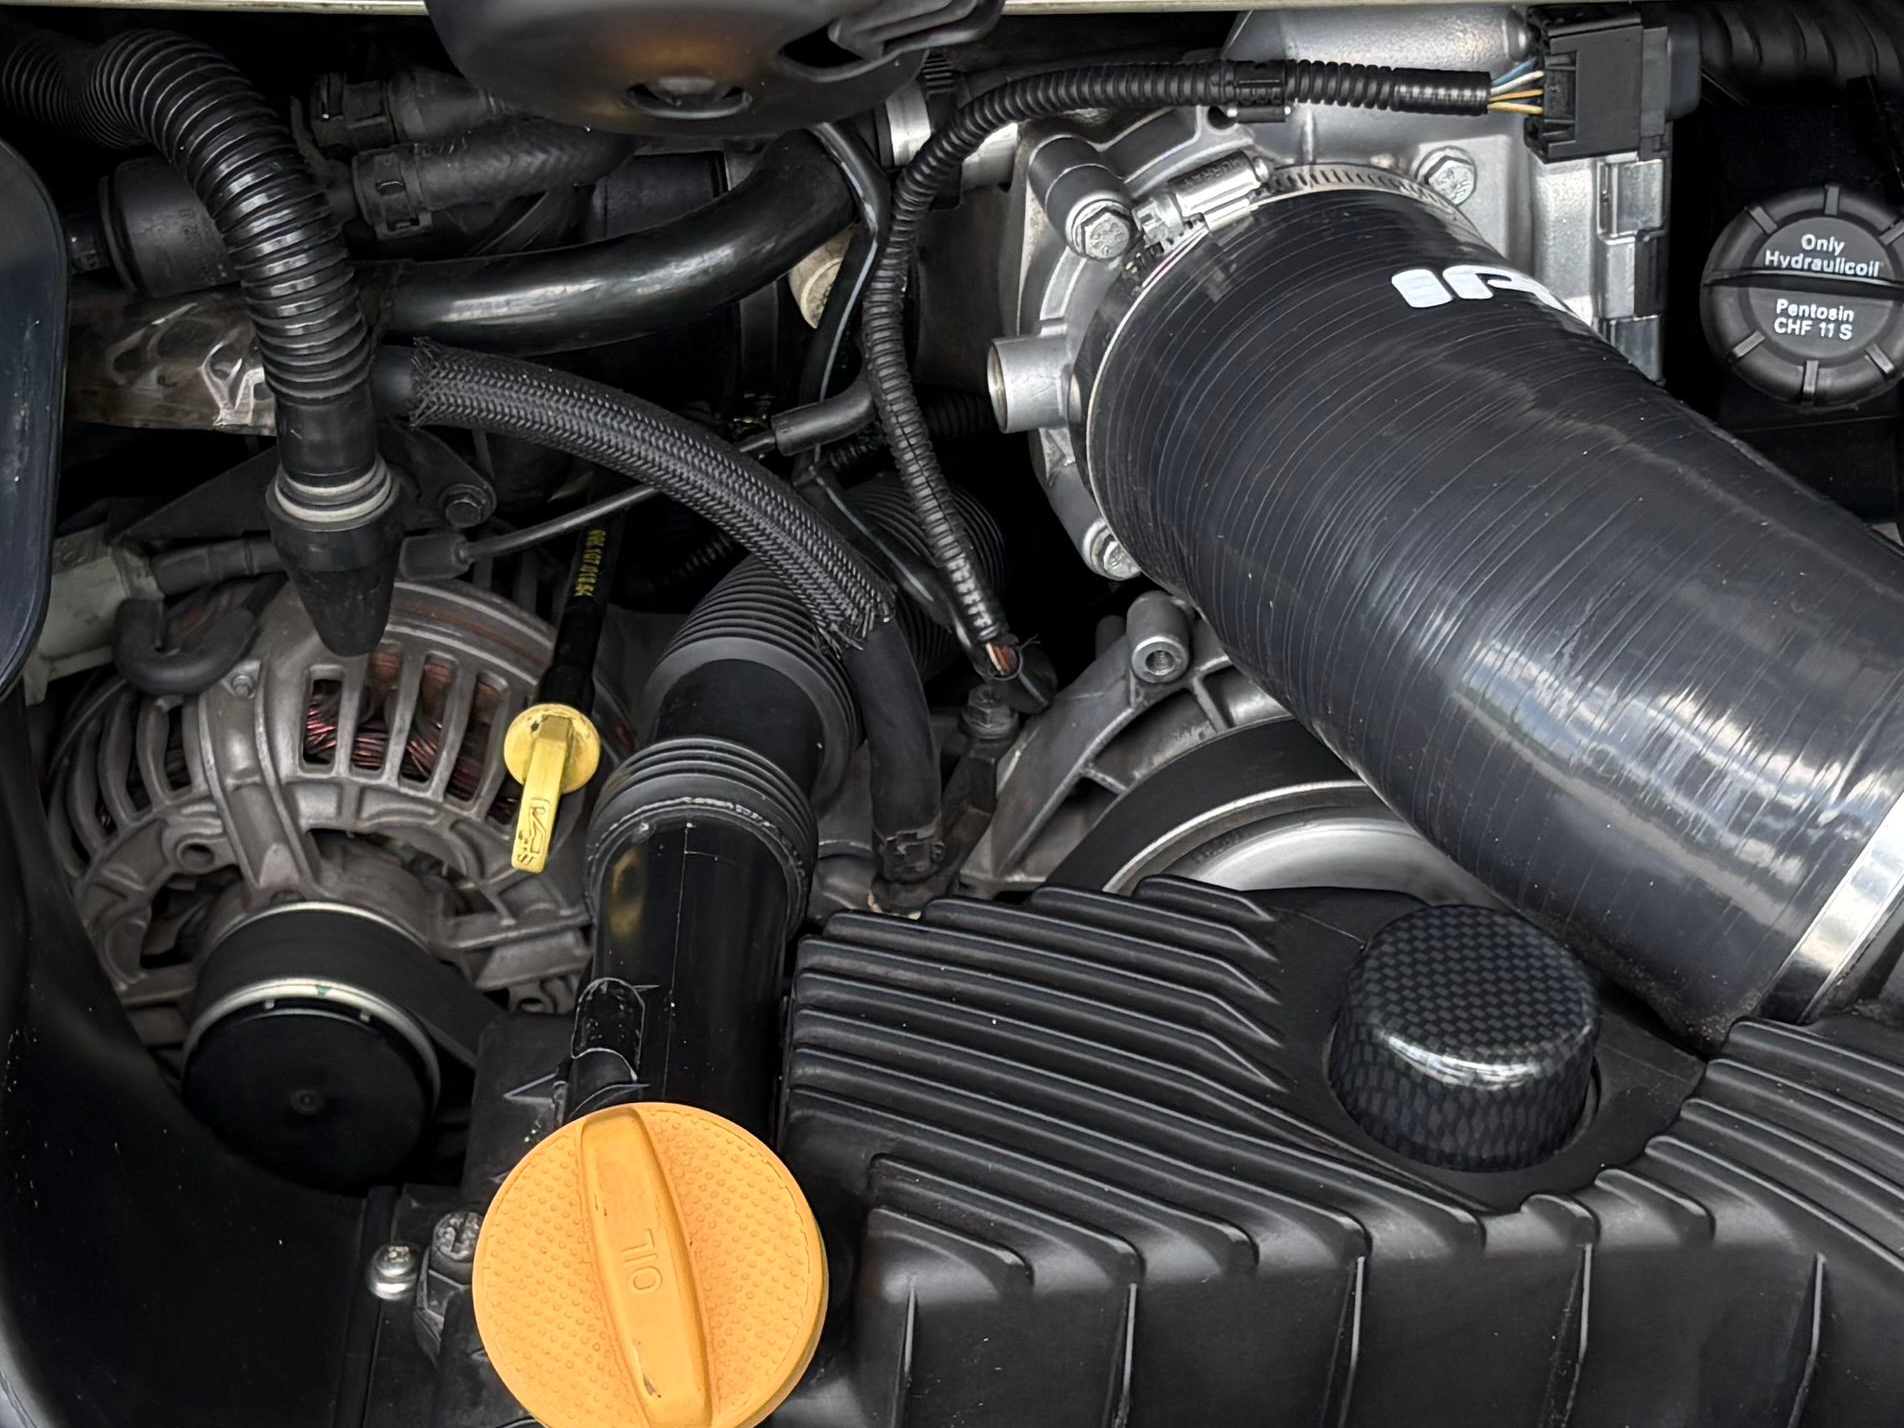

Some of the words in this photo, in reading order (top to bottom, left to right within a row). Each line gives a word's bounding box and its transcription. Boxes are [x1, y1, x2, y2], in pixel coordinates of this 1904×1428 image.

[1800, 233, 1846, 259] Only
[1764, 248, 1883, 279] Hydraulicoil
[1775, 297, 1855, 324] Pentosin
[1772, 315, 1815, 339] CHF
[1818, 318, 1836, 340] 11
[1838, 321, 1853, 342] S
[620, 1228, 664, 1294] OIL
